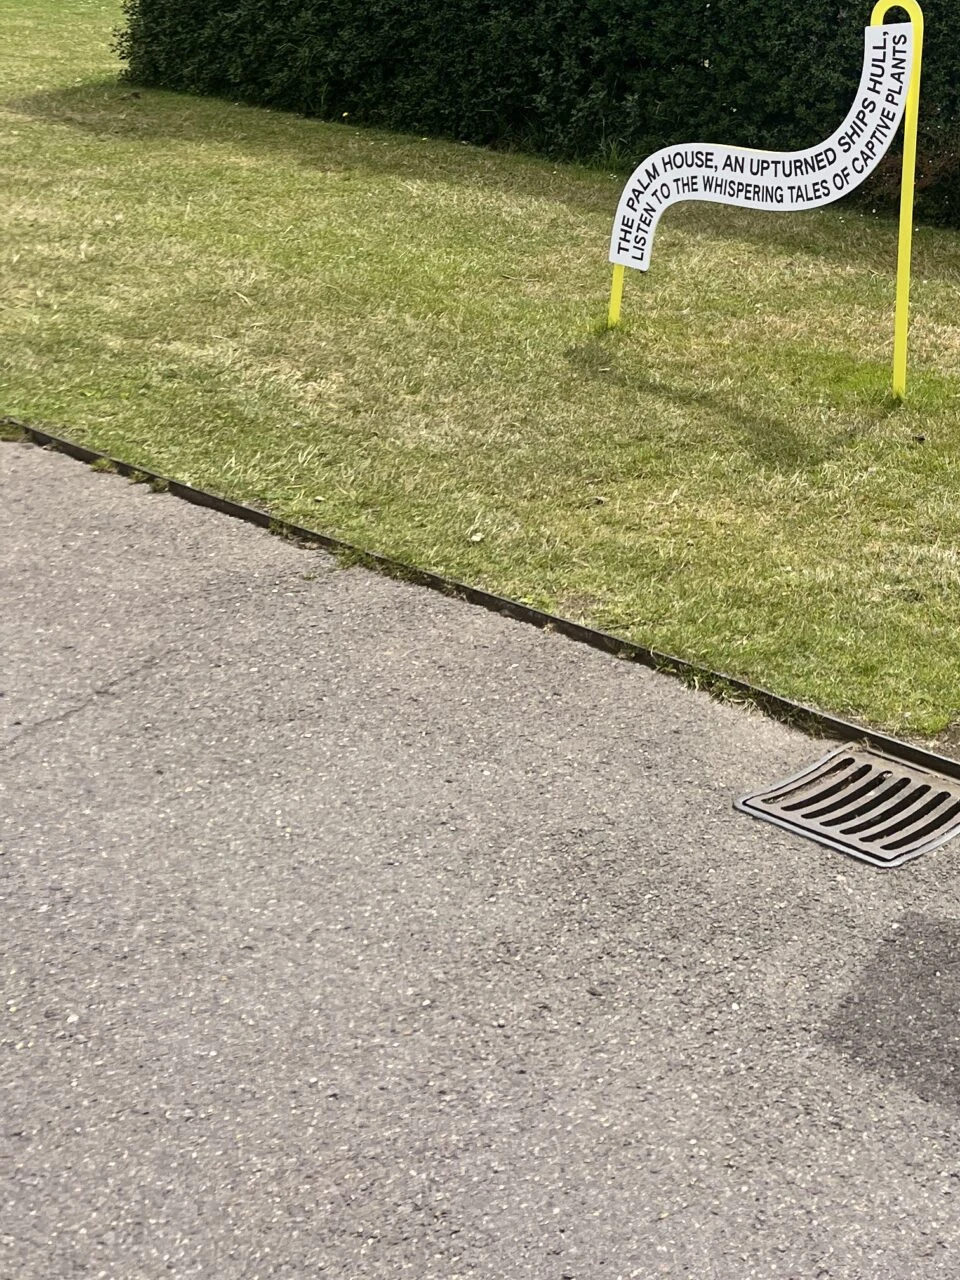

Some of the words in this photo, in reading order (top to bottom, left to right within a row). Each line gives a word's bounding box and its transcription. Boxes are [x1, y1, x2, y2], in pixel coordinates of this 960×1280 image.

[617, 215, 635, 255] THE
[626, 163, 660, 212] PALM
[661, 150, 718, 173] HOUSE,
[722, 154, 745, 174] AN
[750, 147, 837, 178] UPTURNED
[838, 97, 877, 153] SHIPS
[867, 31, 889, 95] HULL,
[632, 202, 657, 261] LISTEN
[651, 182, 671, 205] TO
[673, 175, 699, 195] THE
[702, 174, 784, 204] WHISPERING
[787, 179, 831, 204] TALES
[832, 166, 851, 191] OF
[851, 107, 897, 175] CAPTIVE
[885, 33, 908, 106] PLANTS
